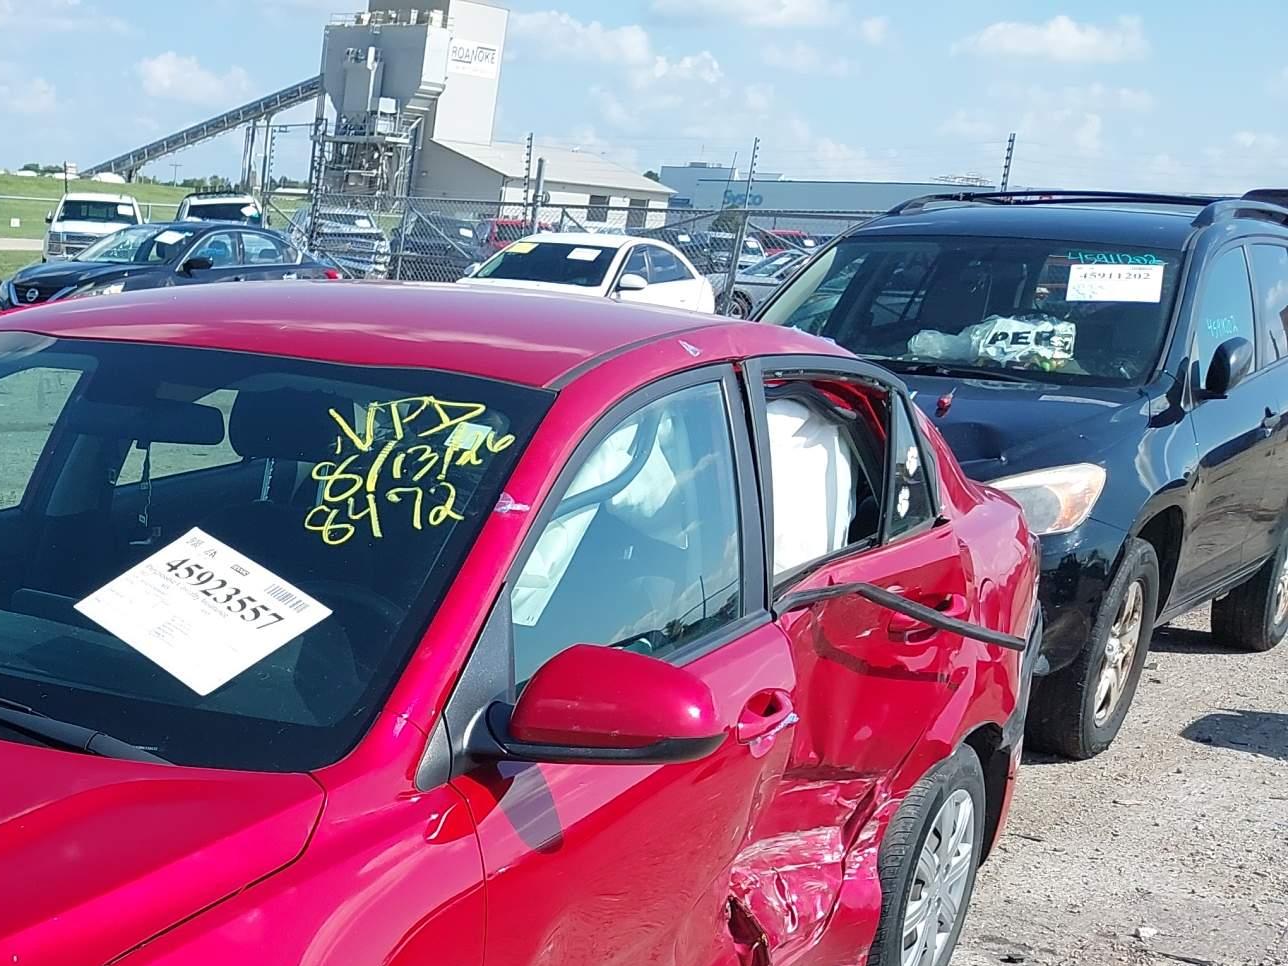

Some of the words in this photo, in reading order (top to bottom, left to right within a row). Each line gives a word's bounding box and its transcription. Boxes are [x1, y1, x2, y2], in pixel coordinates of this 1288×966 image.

[451, 45, 496, 64] ROANOKE
[1066, 251, 1169, 265] 45911202
[1079, 271, 1152, 281] 45911202
[165, 558, 285, 630] 45923557
